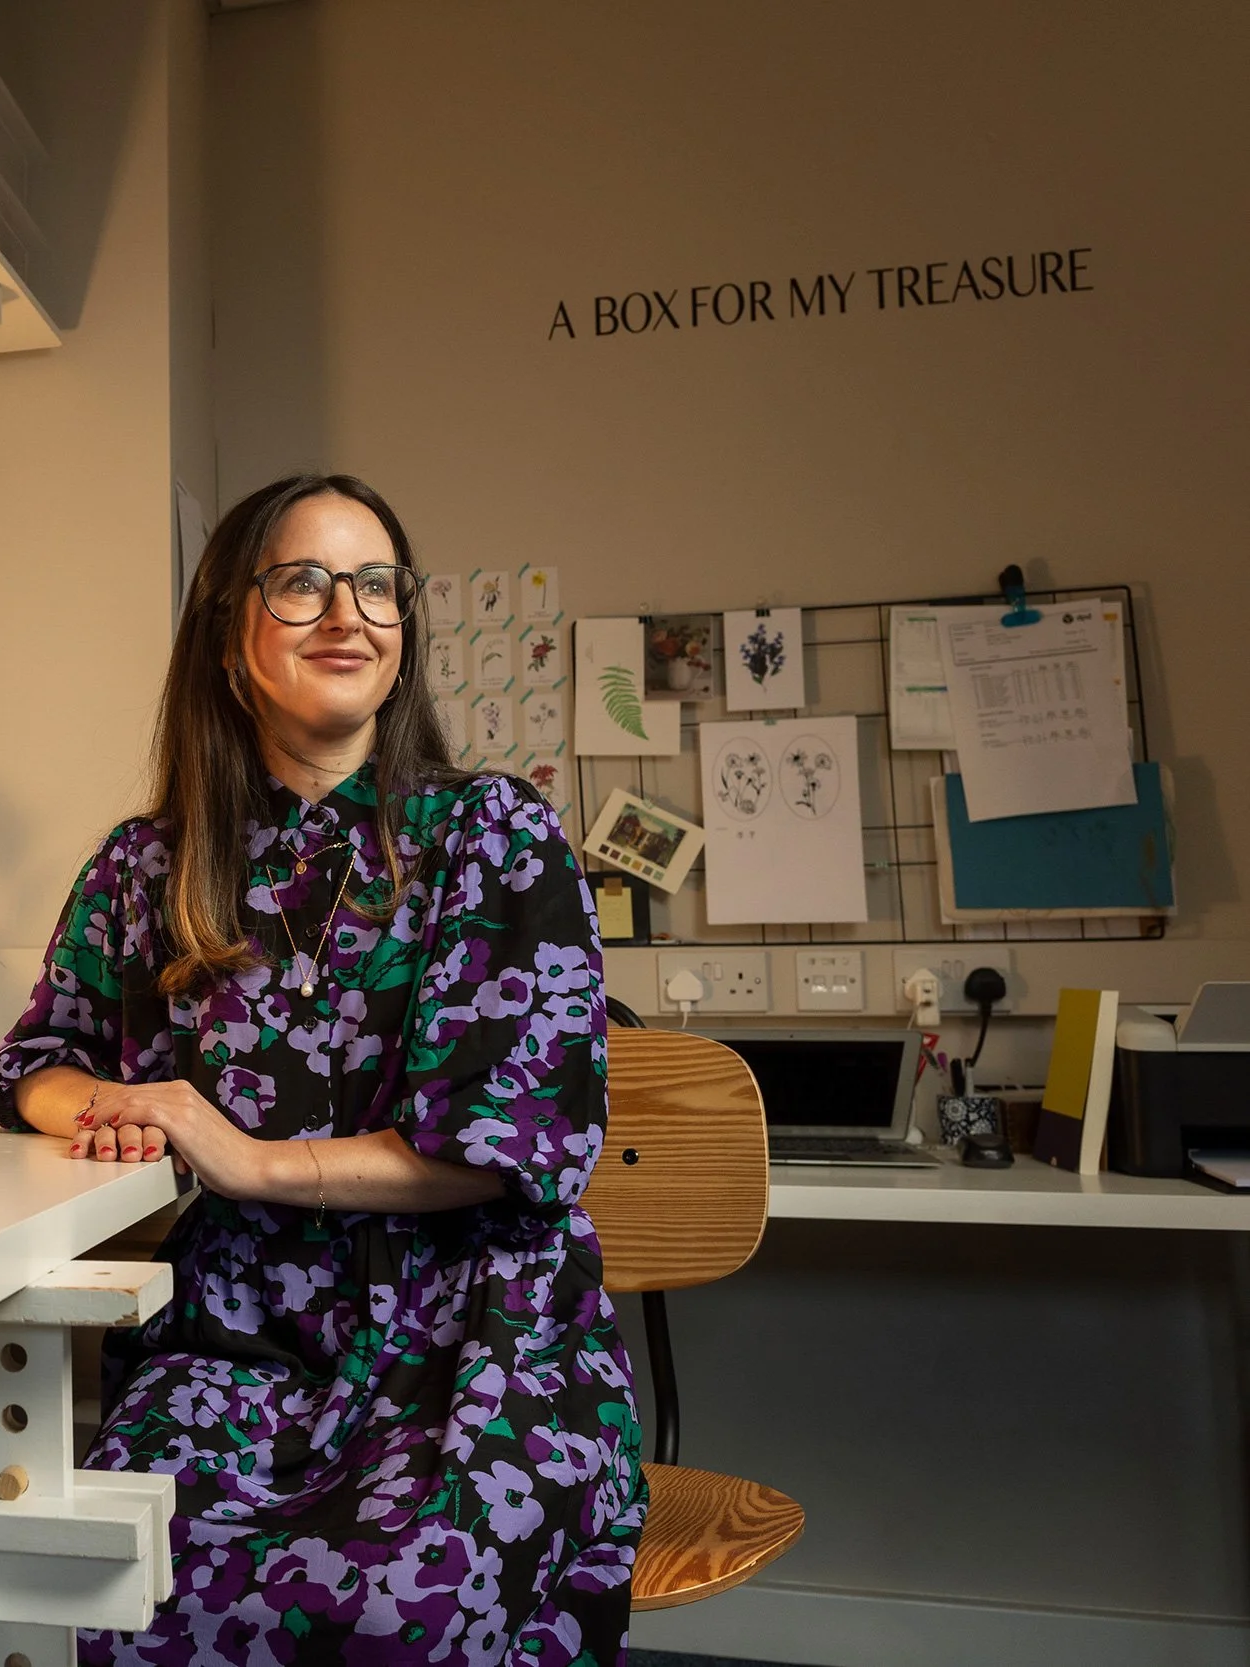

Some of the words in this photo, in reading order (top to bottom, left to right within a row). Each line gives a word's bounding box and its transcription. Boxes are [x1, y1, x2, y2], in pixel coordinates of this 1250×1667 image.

[548, 300, 576, 341] A
[594, 289, 681, 337] BOX
[690, 280, 776, 328] FOR
[789, 271, 856, 319] MY
[866, 247, 1094, 310] TREASURE
